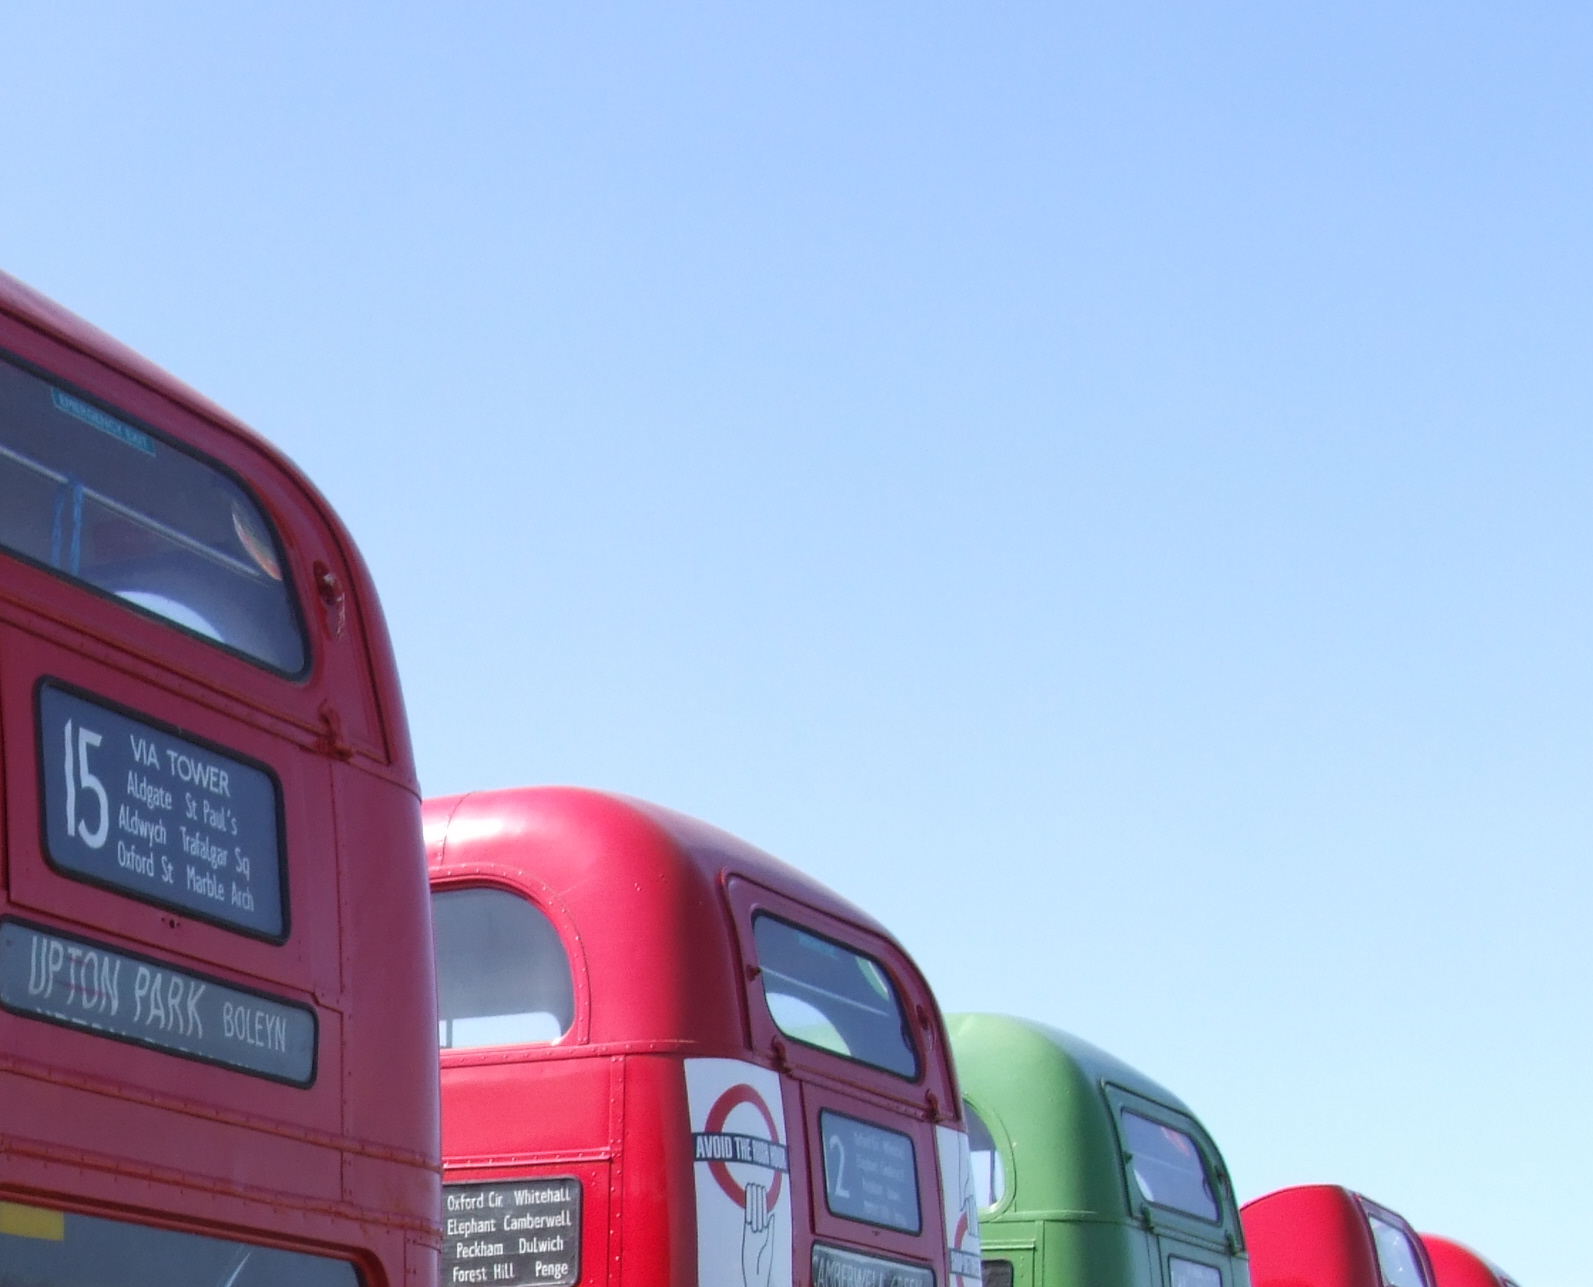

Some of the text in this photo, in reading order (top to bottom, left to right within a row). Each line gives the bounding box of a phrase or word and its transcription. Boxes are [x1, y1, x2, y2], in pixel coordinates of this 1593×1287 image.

[64, 718, 109, 849] 15
[130, 734, 230, 797] VIA TOWER
[127, 771, 237, 835] Aldgate St Paul's
[118, 805, 250, 881] Aldwych Trafalgar Sq
[117, 842, 254, 912] Oxford St Marble Arch
[28, 936, 122, 1017] UPTON
[133, 966, 206, 1040] PARK
[223, 1002, 287, 1053] BOLEYN
[695, 1135, 733, 1159] AVOID
[734, 1137, 752, 1161] THE
[447, 1192, 484, 1212] Oxford
[514, 1186, 571, 1206] Whitehall
[447, 1210, 571, 1239] Elephant Camberwell
[453, 1260, 568, 1284] Forest Hill Penge
[456, 1235, 564, 1259] Peckham Dulwich
